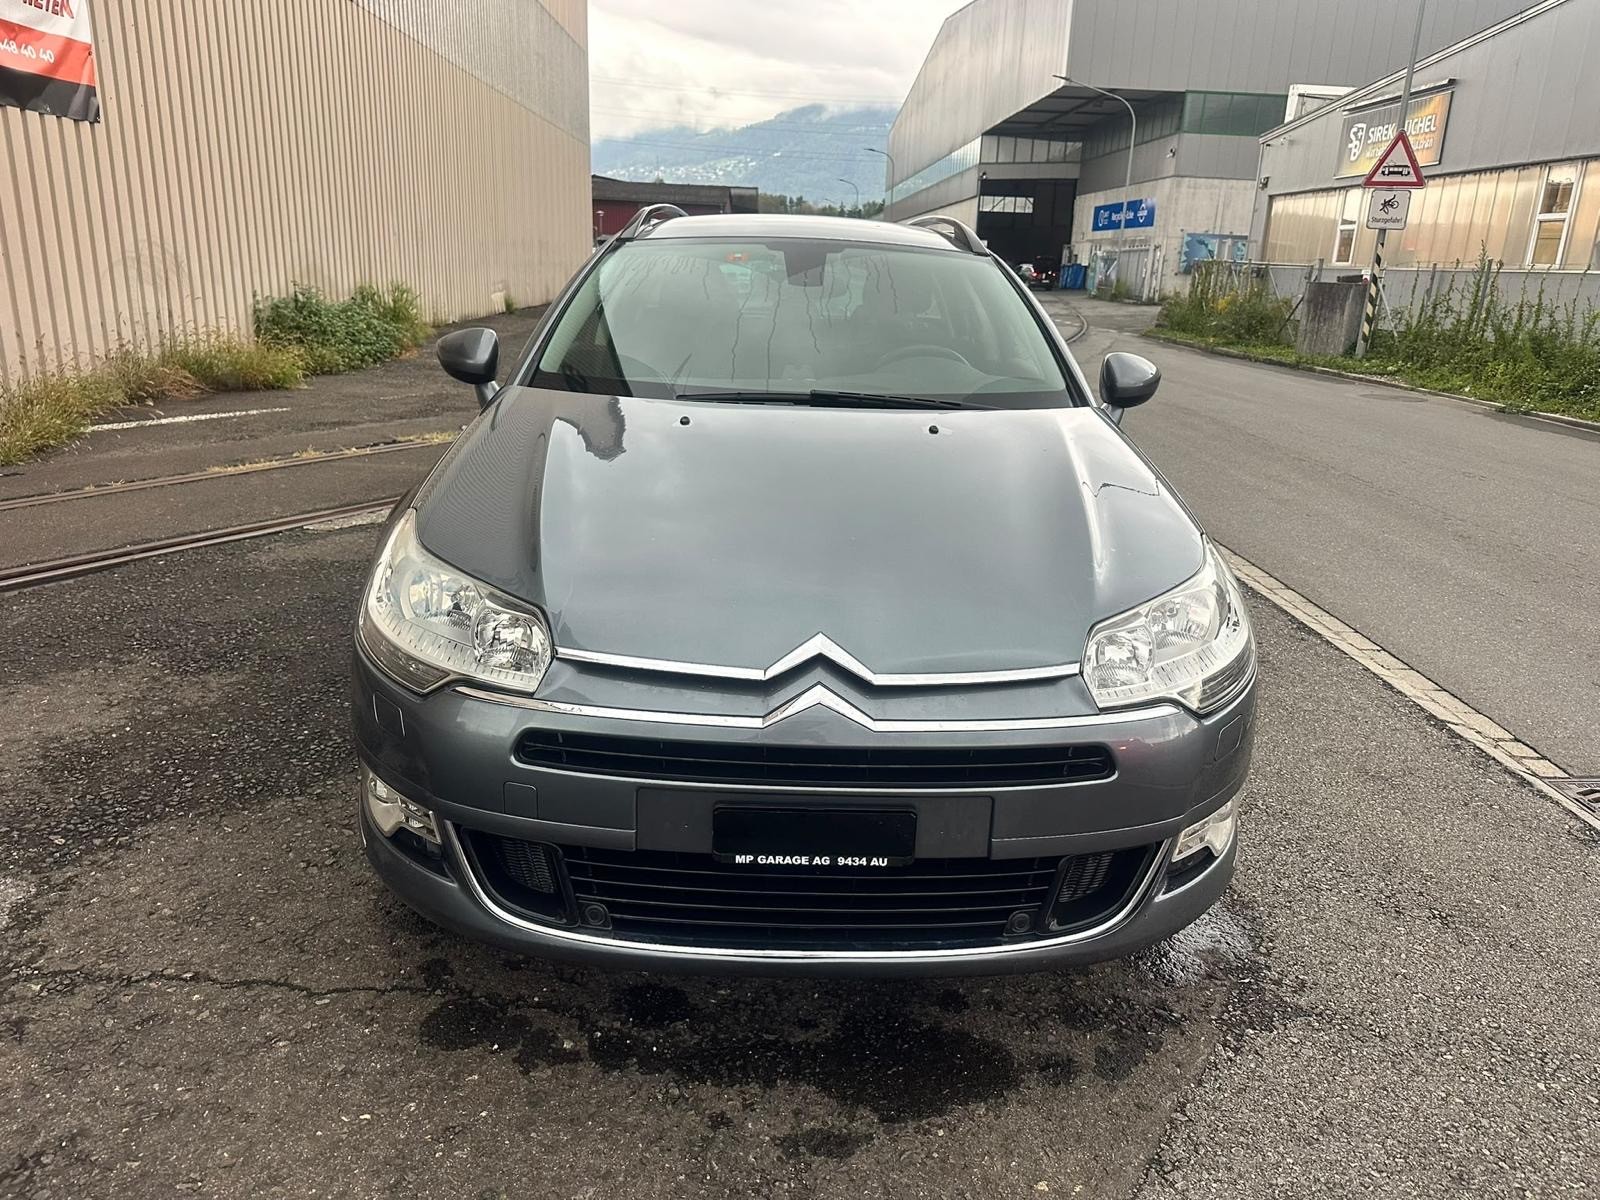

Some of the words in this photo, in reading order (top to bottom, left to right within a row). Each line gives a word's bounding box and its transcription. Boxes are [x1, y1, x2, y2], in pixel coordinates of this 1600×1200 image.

[20, 43, 37, 59] 40
[39, 47, 55, 64] 40
[1367, 123, 1395, 143] SIREK
[735, 854, 754, 864] MP
[757, 855, 809, 865] GARAGE
[812, 856, 830, 866] AG
[837, 856, 867, 866] 9434
[870, 857, 888, 867] AU
